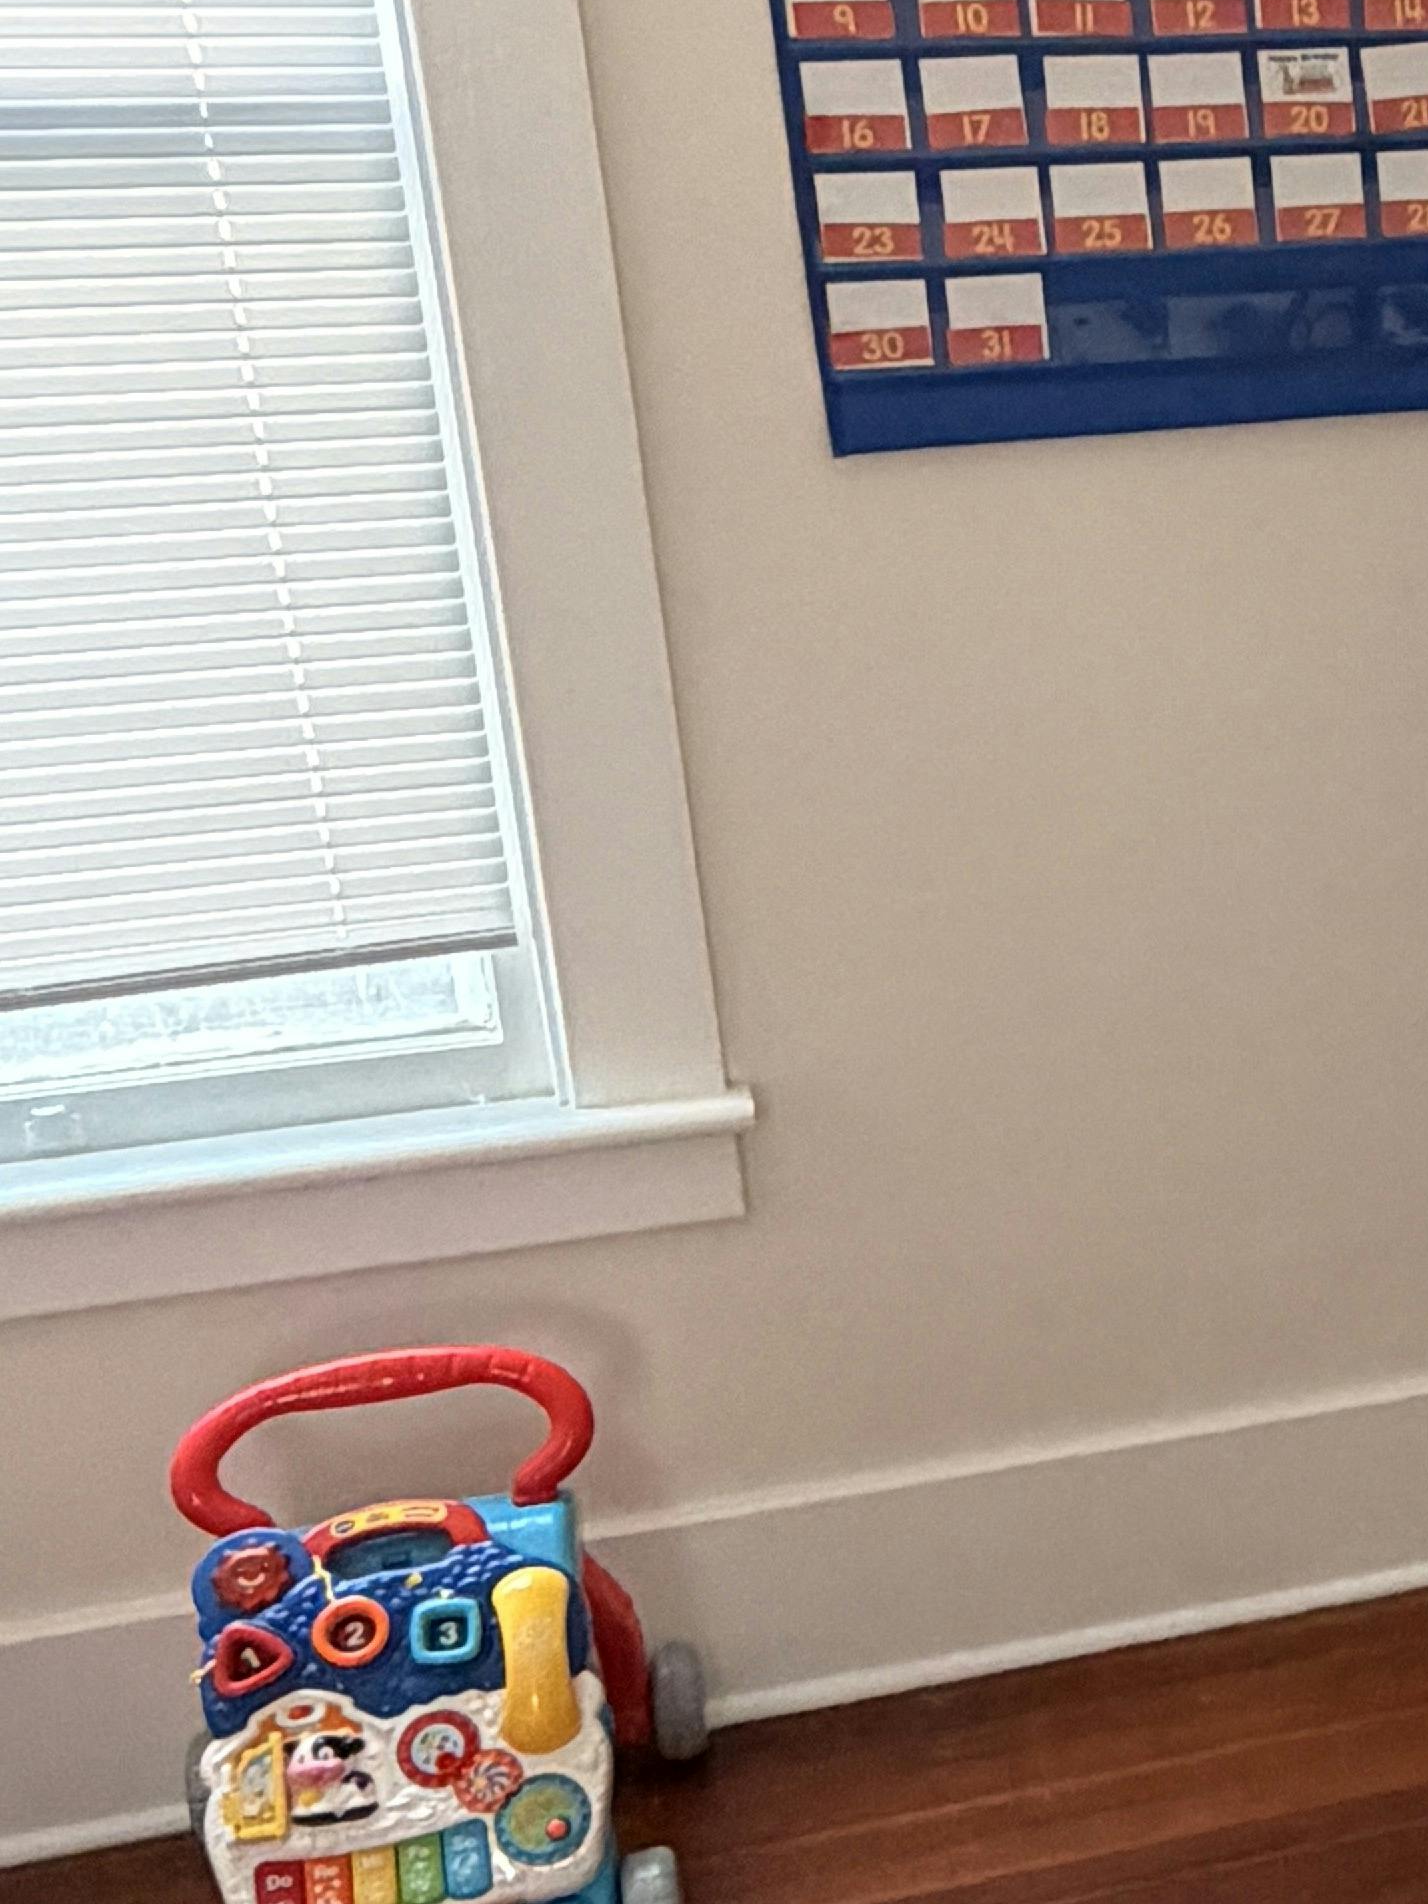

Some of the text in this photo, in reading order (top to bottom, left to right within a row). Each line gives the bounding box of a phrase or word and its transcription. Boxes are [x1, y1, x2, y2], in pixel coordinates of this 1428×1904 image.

[833, 5, 855, 32] 9
[955, 3, 988, 30] 10
[1076, 2, 1095, 31] 11
[1185, 1, 1214, 29] 12
[841, 119, 874, 148] 16
[963, 114, 991, 143] 17
[1080, 109, 1110, 138] 18
[1188, 108, 1216, 136] 19
[1290, 105, 1329, 134] 20
[852, 226, 895, 256] 23
[972, 225, 1016, 254] 24
[1082, 217, 1122, 247] 25
[1193, 213, 1232, 242] 26
[1305, 208, 1341, 236] 27
[862, 330, 1013, 360] 30 31
[241, 1620, 458, 1667] 1 2 3
[265, 1872, 294, 1891] Do
